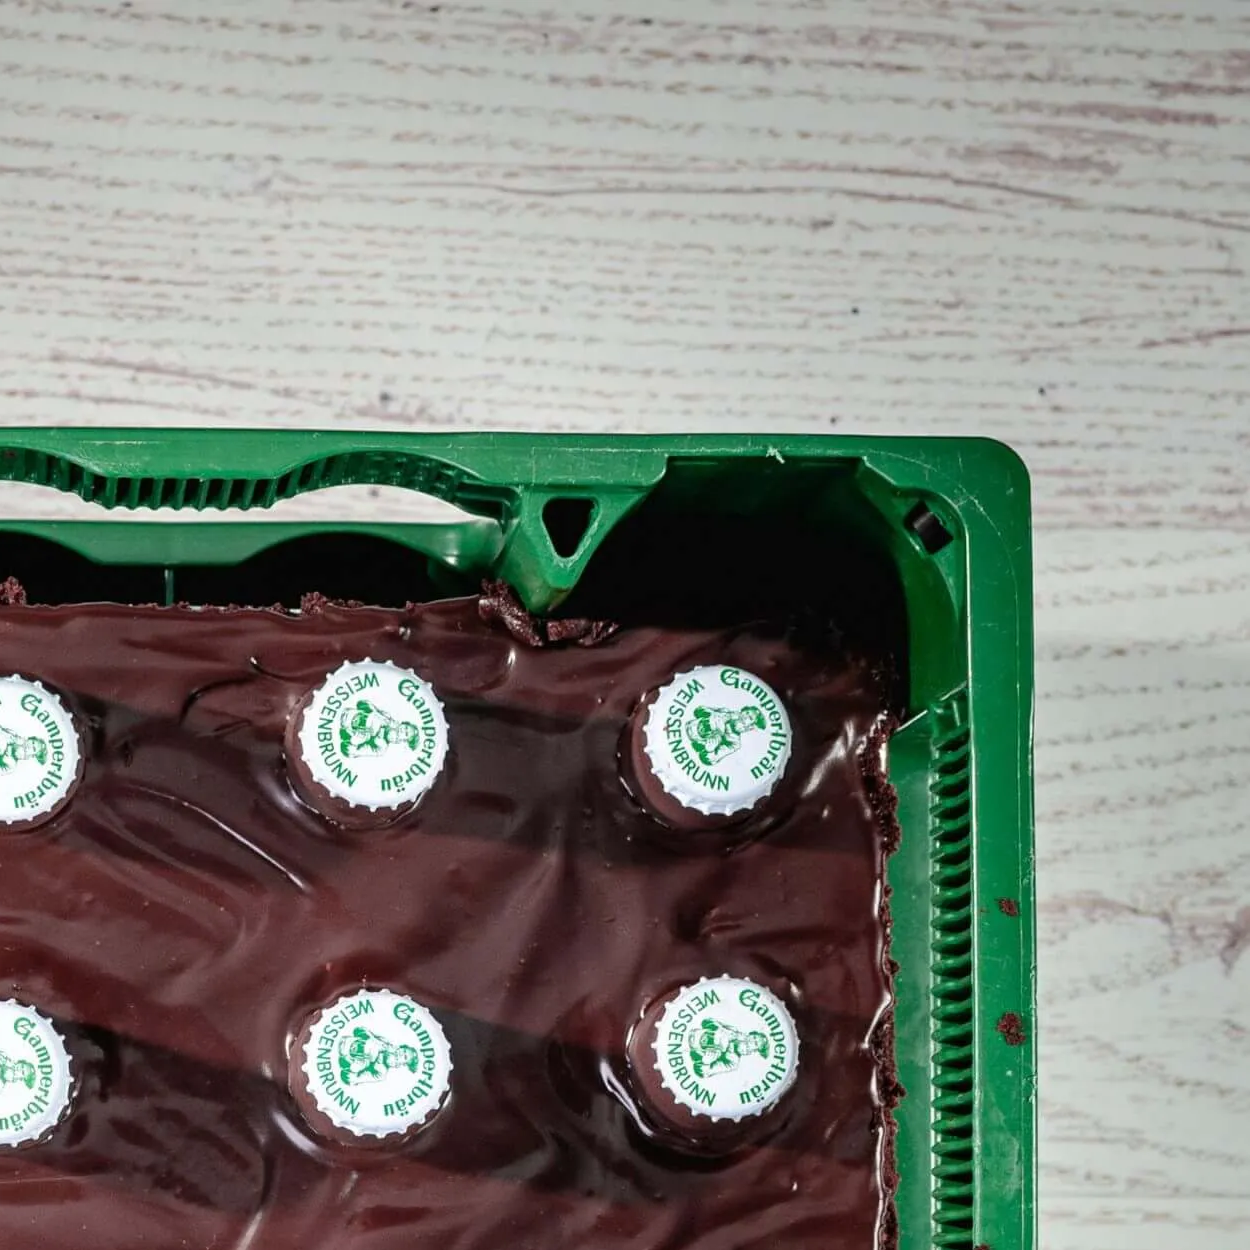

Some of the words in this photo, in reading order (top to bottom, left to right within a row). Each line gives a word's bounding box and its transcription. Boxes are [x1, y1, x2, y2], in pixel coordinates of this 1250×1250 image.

[14, 693, 63, 808] Gampertbräu
[318, 672, 379, 788] WEISSENBRUNN
[381, 678, 436, 793] Gampertbräu
[667, 680, 730, 791] WEISSENBRUNN
[720, 669, 786, 780] Gampertbräu
[317, 999, 374, 1117] WEISSENBRUNN
[383, 1002, 435, 1117] Gampertbräu
[667, 989, 720, 1107] WEISSENBRUNN
[739, 988, 787, 1104] Gampertbräu
